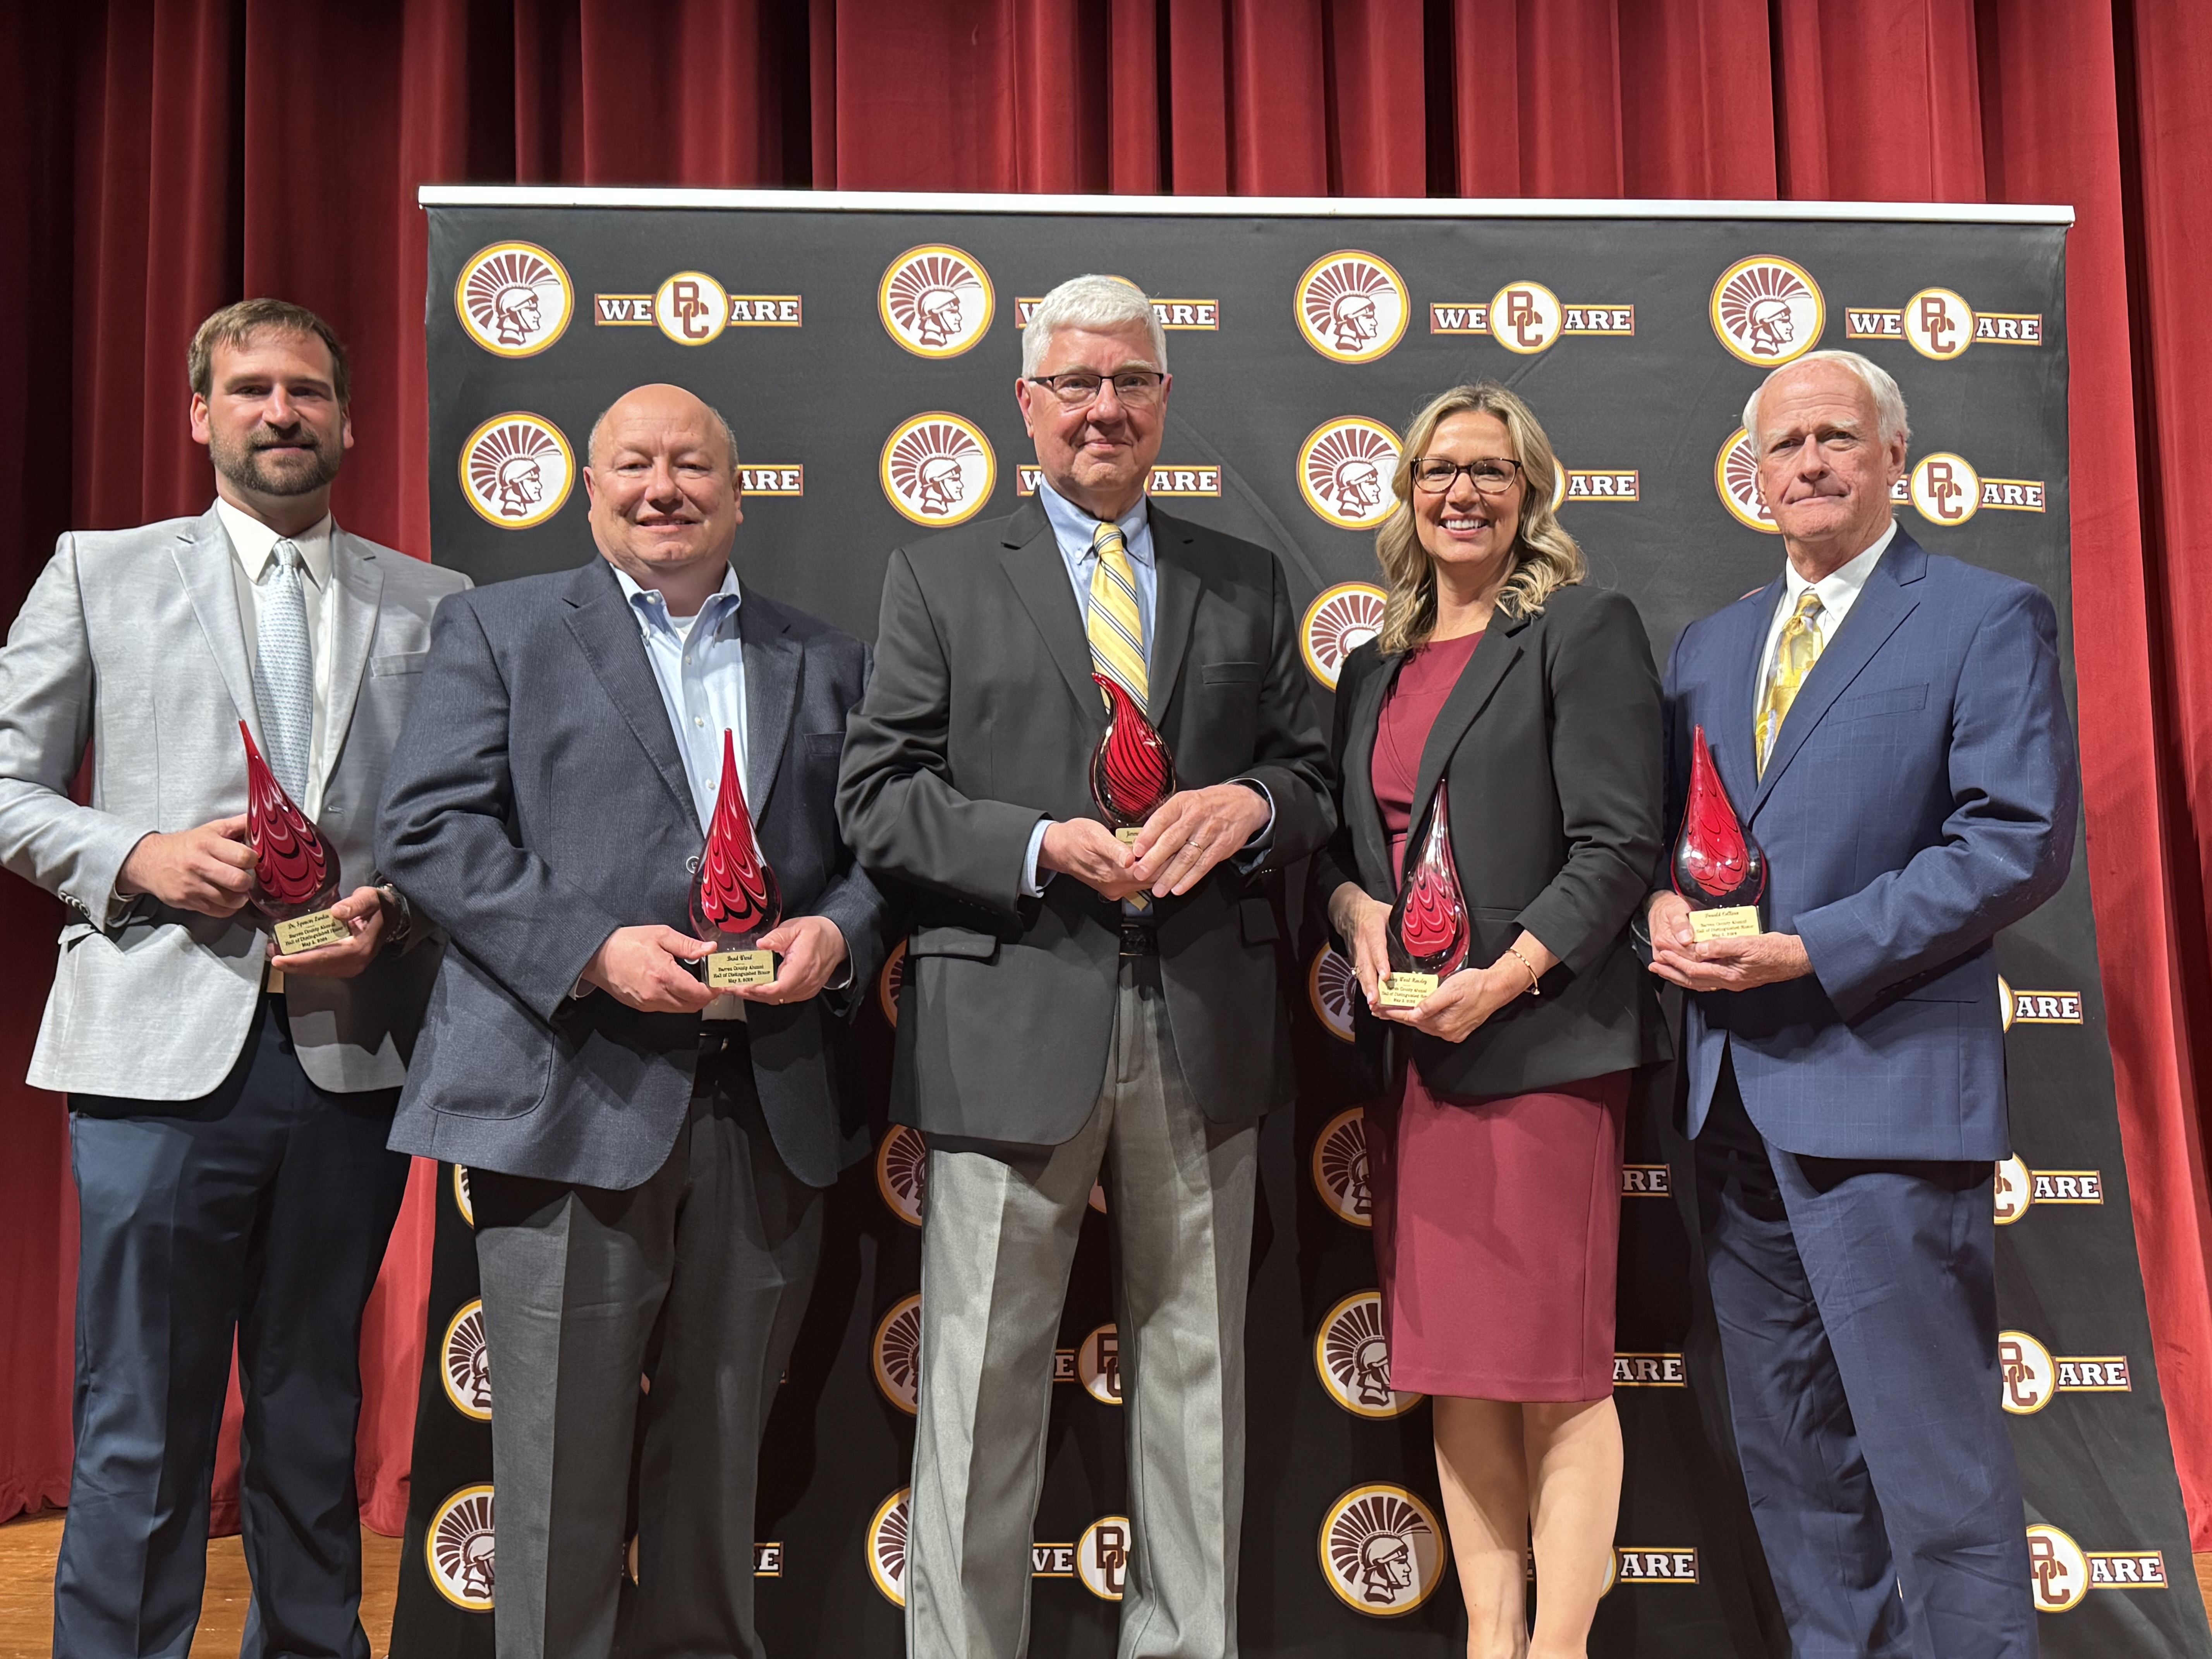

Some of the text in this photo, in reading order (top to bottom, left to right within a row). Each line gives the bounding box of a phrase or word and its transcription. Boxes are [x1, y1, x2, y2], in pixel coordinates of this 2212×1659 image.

[599, 282, 798, 338] WE BC ARE
[1153, 305, 1215, 324] ARE
[1434, 292, 1630, 347] WE BC ARE
[1850, 297, 2038, 353] WE BC ARE
[1151, 471, 1217, 491] ARE
[1568, 476, 1635, 495] ARE
[1928, 462, 1962, 519] BC
[1982, 484, 2042, 506] ARE
[2016, 997, 2079, 1018] ARE
[1623, 1170, 1668, 1191] RE
[2034, 1177, 2099, 1197] ARE
[1613, 1359, 1683, 1380] ARE
[2059, 1363, 2127, 1385] ARE
[1621, 1554, 1694, 1577] ARE
[2091, 1558, 2163, 1582] ARE
